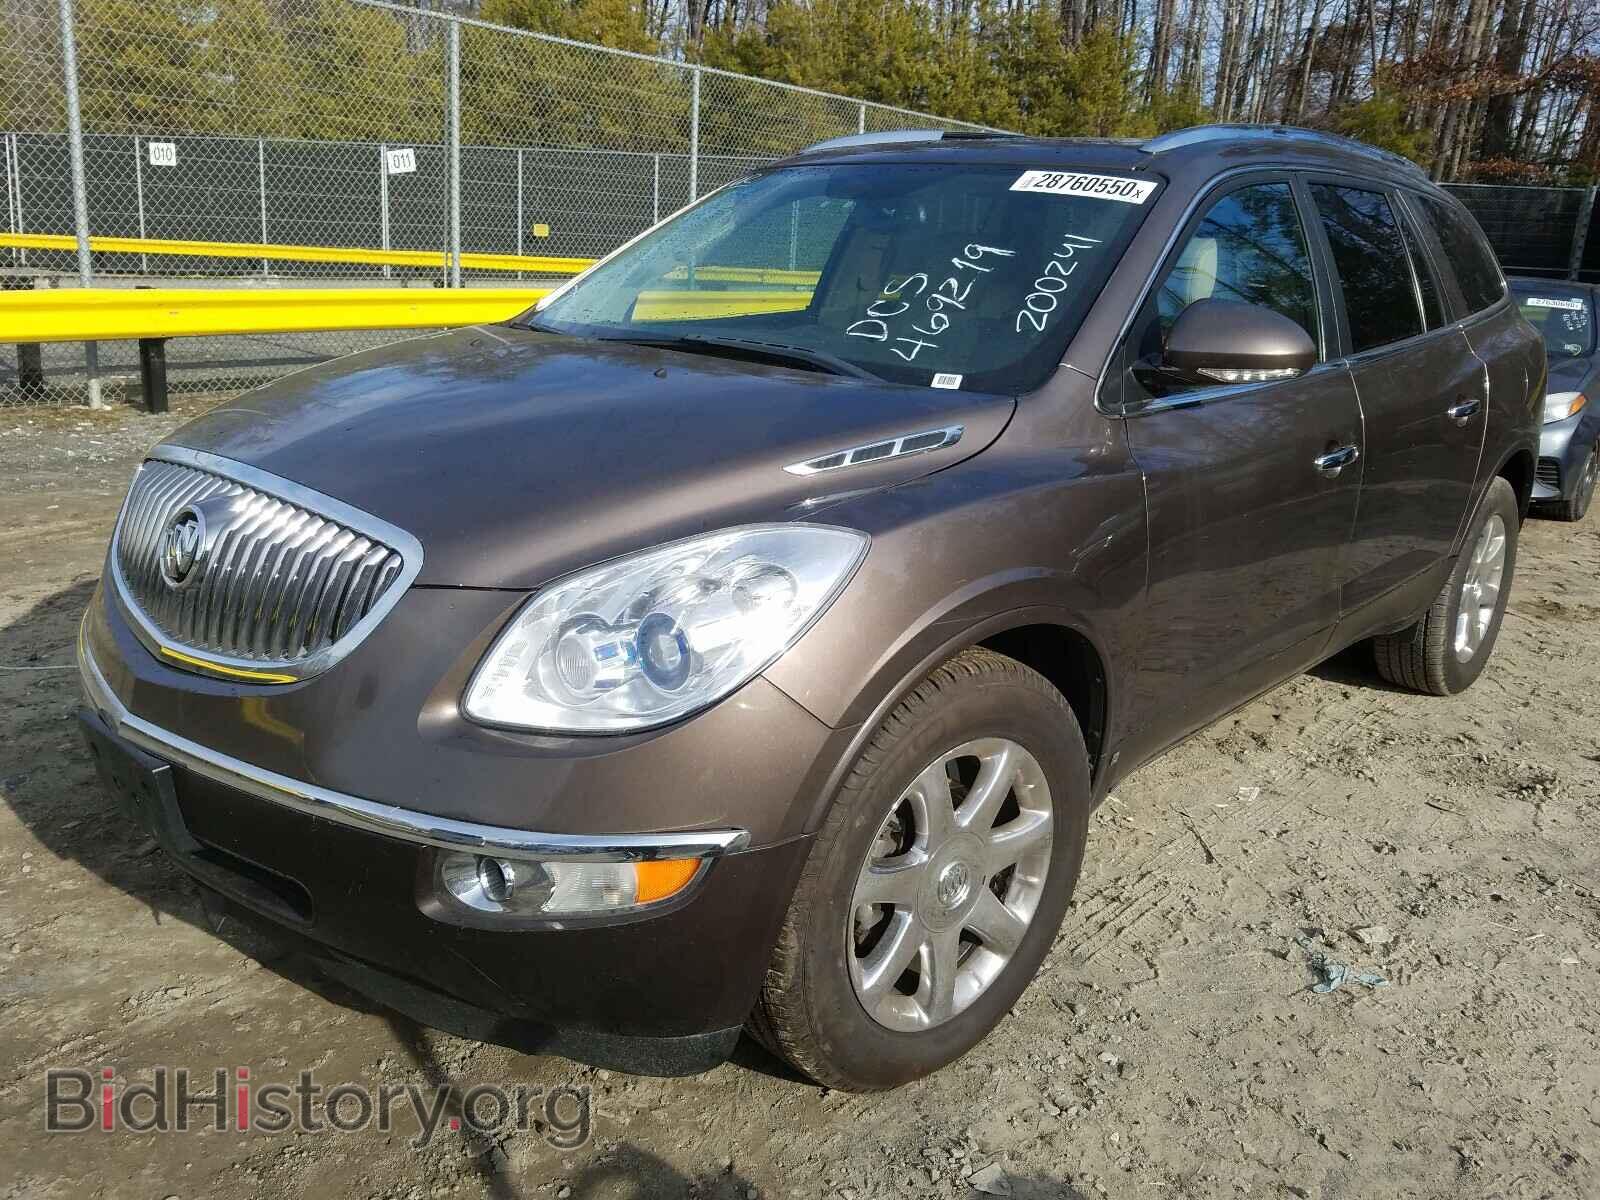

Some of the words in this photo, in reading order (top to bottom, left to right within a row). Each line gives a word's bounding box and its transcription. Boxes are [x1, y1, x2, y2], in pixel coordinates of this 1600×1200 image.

[153, 146, 172, 161] 010
[393, 153, 413, 169] 011
[846, 272, 929, 342] DCS
